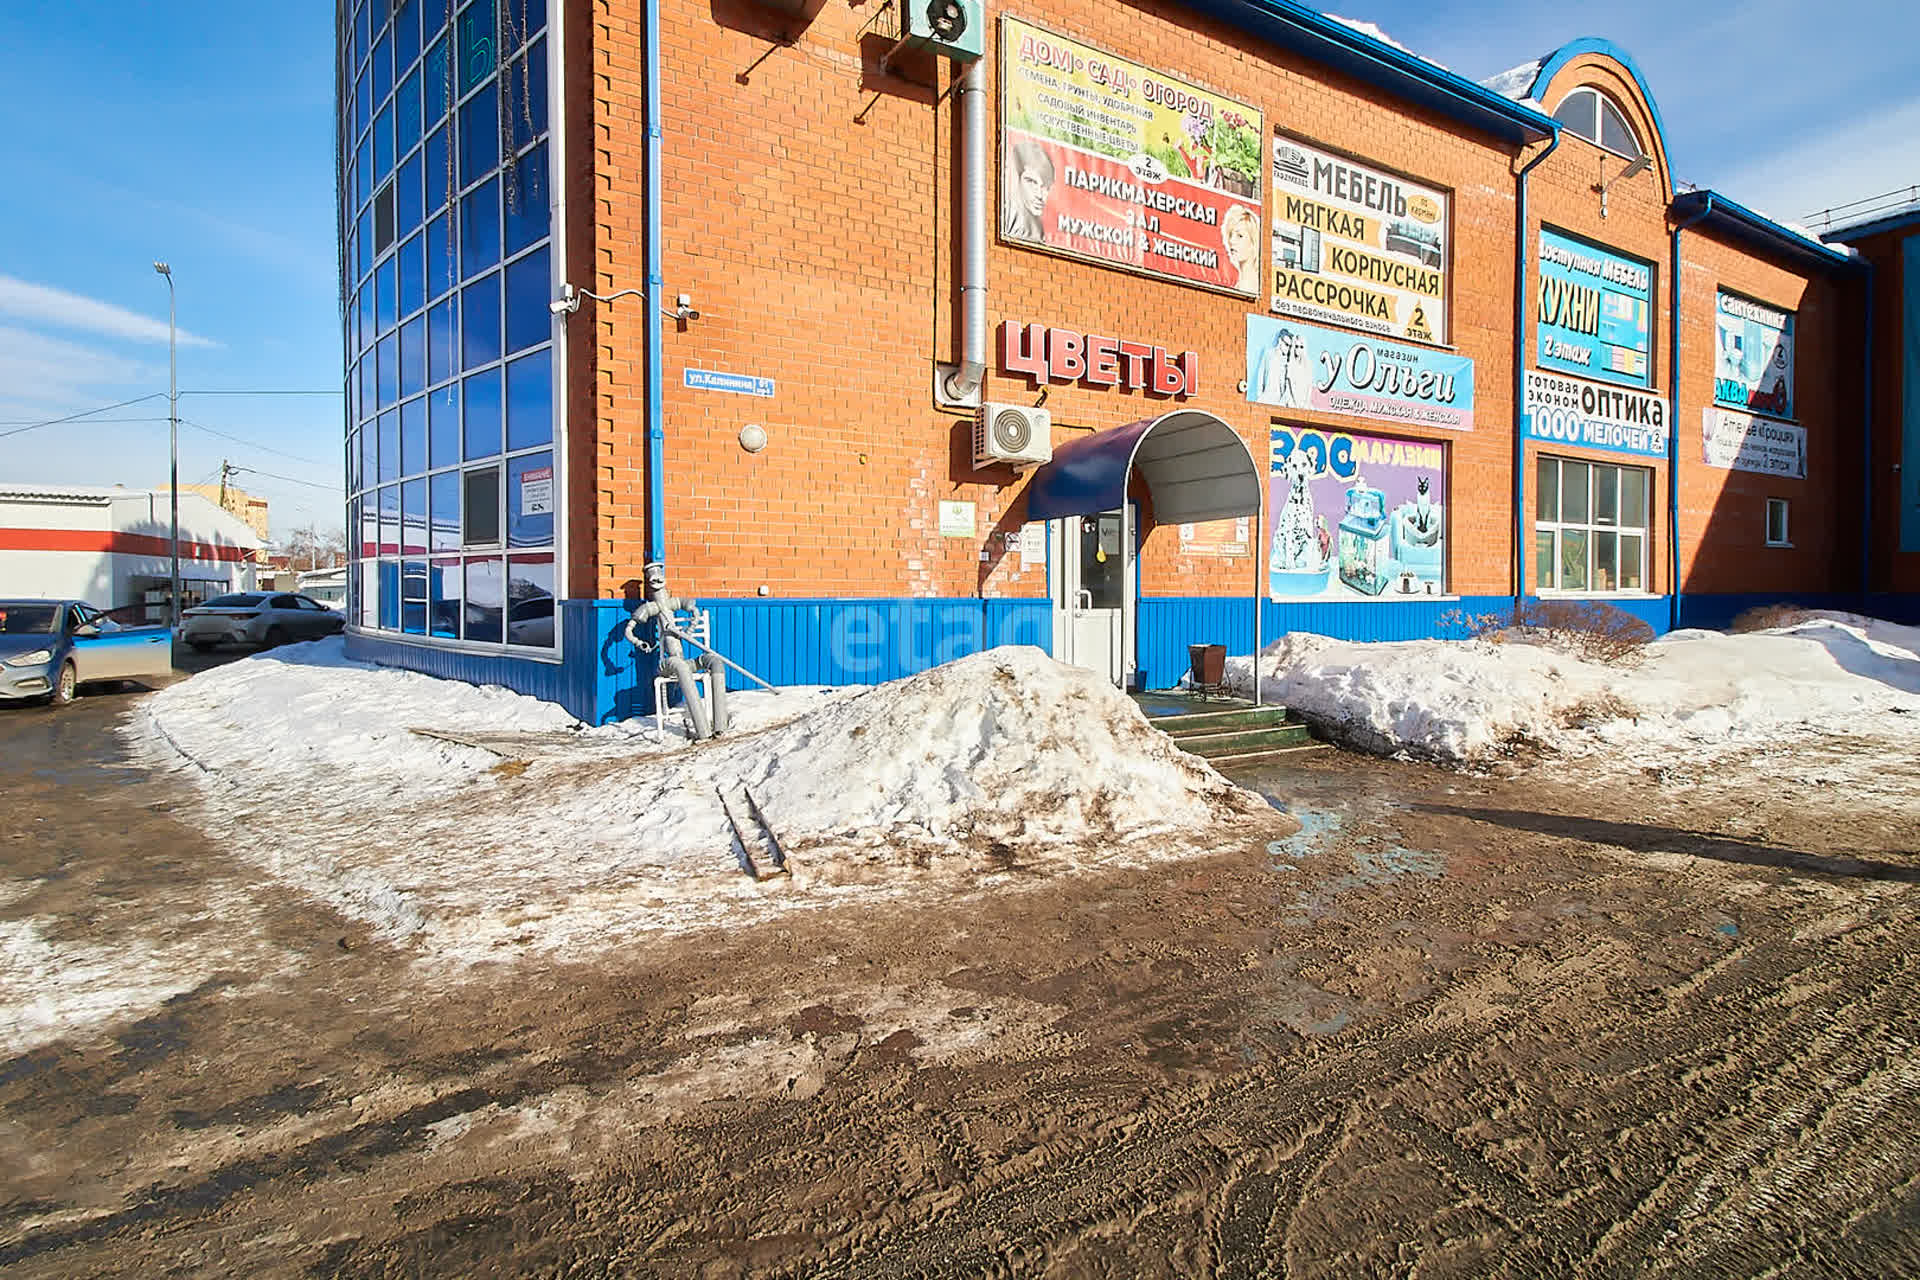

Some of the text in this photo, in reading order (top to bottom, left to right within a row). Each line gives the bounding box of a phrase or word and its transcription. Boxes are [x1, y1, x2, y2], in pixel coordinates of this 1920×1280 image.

[1018, 33, 1215, 127] ДОМ САД ОГОРОД
[1036, 92, 1137, 135] САДОВЫЙ ИНВЕНТАРЬ
[1135, 166, 1161, 181] этаж
[1145, 156, 1152, 168] 2
[1064, 166, 1218, 226] ПАРИКМАХЕРСКАЯ
[1313, 156, 1408, 219] МЕБЕЛЬ
[1125, 208, 1161, 234] ЗАЛ
[1286, 195, 1365, 241] МЯГКАЯ
[1057, 214, 1135, 248] МУЖСКОЙ
[1152, 237, 1219, 270] ЖЕНСКИЙ
[1331, 246, 1440, 296] КОРПУСНАЯ
[1275, 271, 1390, 320] РАССРОЧКА
[1414, 307, 1424, 327] 2
[1538, 275, 1601, 337] КУХНИ
[1376, 348, 1419, 363] магазин
[1406, 326, 1433, 342] этаж
[1543, 335, 1592, 366] 2 этаж
[1002, 319, 1199, 398] ЦВЕТЫ
[1527, 374, 1580, 396] готовая
[1527, 389, 1580, 410] эконом
[1527, 403, 1649, 450] 1000 МЕЛОЧЕЙ
